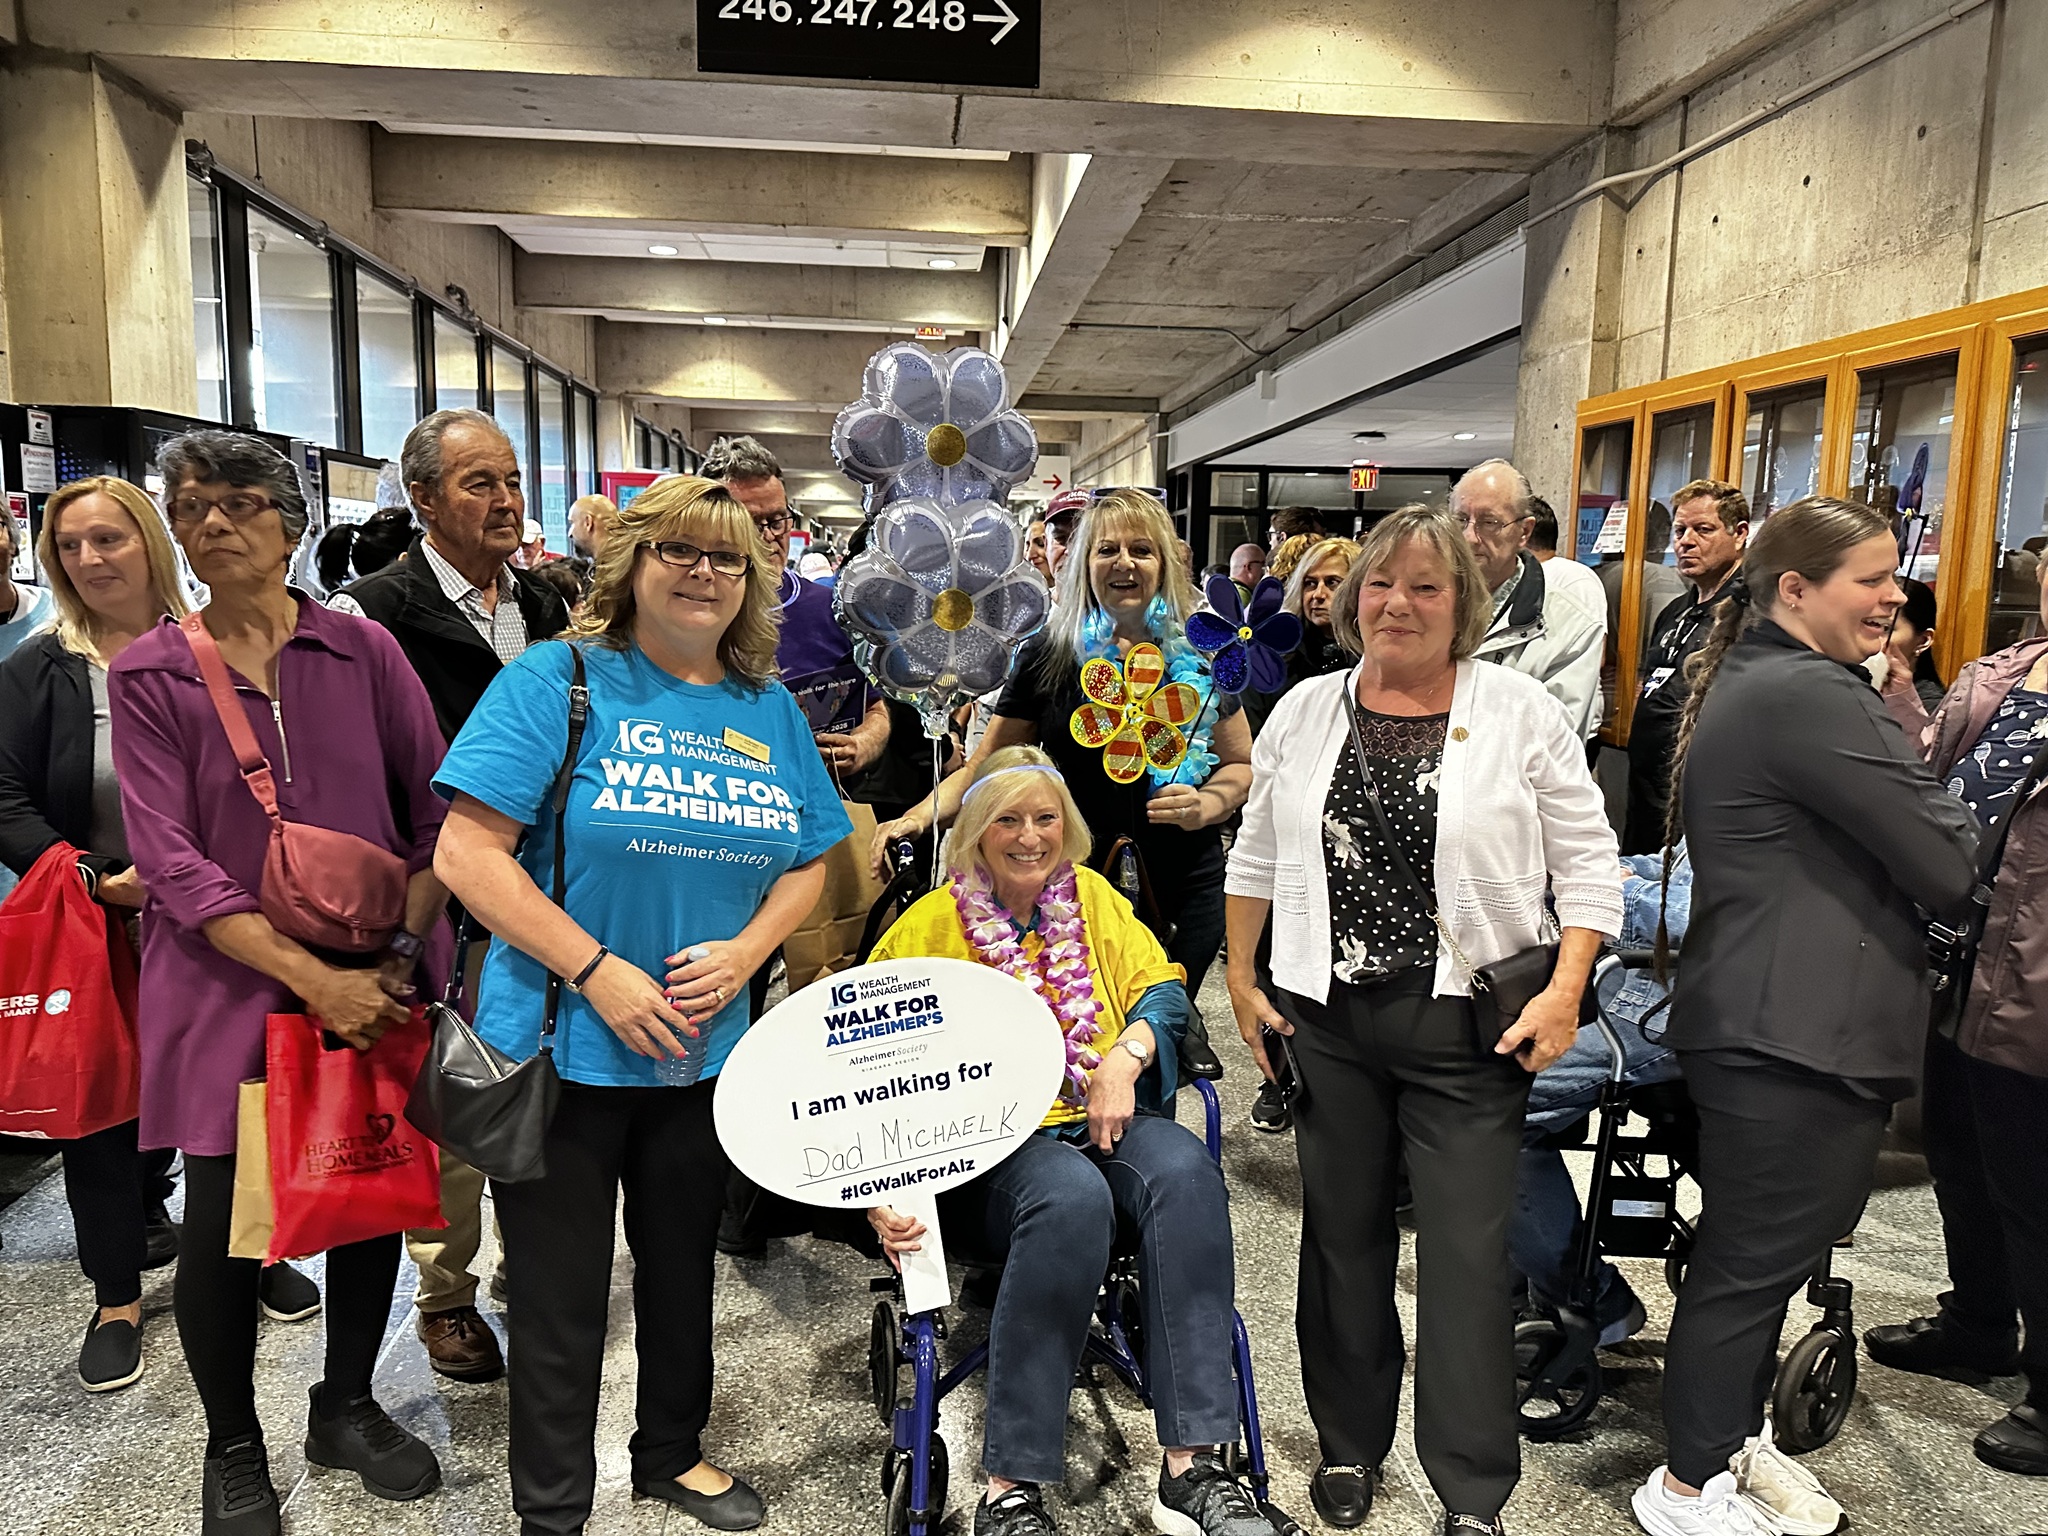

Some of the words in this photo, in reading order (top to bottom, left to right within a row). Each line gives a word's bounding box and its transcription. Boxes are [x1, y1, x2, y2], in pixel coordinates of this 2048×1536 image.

[1351, 469, 1378, 489] EXIT
[668, 729, 732, 752] WEALT
[670, 745, 777, 776] MANAGEMENT
[600, 758, 720, 799] WALK
[726, 776, 794, 810] FOR
[591, 787, 799, 834] ALZHEIMER'S
[831, 983, 858, 1007] IG
[858, 975, 899, 990] WEALTH
[860, 978, 931, 1001] MANAGEMENT
[4, 1007, 39, 1018] MART
[824, 1003, 890, 1031] WALK
[894, 994, 940, 1017] FOR
[826, 1011, 944, 1048] ALZHEIMER'S
[792, 1101, 799, 1120] I
[808, 1094, 847, 1117] am
[854, 1070, 951, 1107] walking
[958, 1061, 993, 1083] for
[306, 1138, 354, 1158] HEART
[801, 1131, 864, 1180] Dad
[841, 1158, 976, 1201] #IGWalkForAlz
